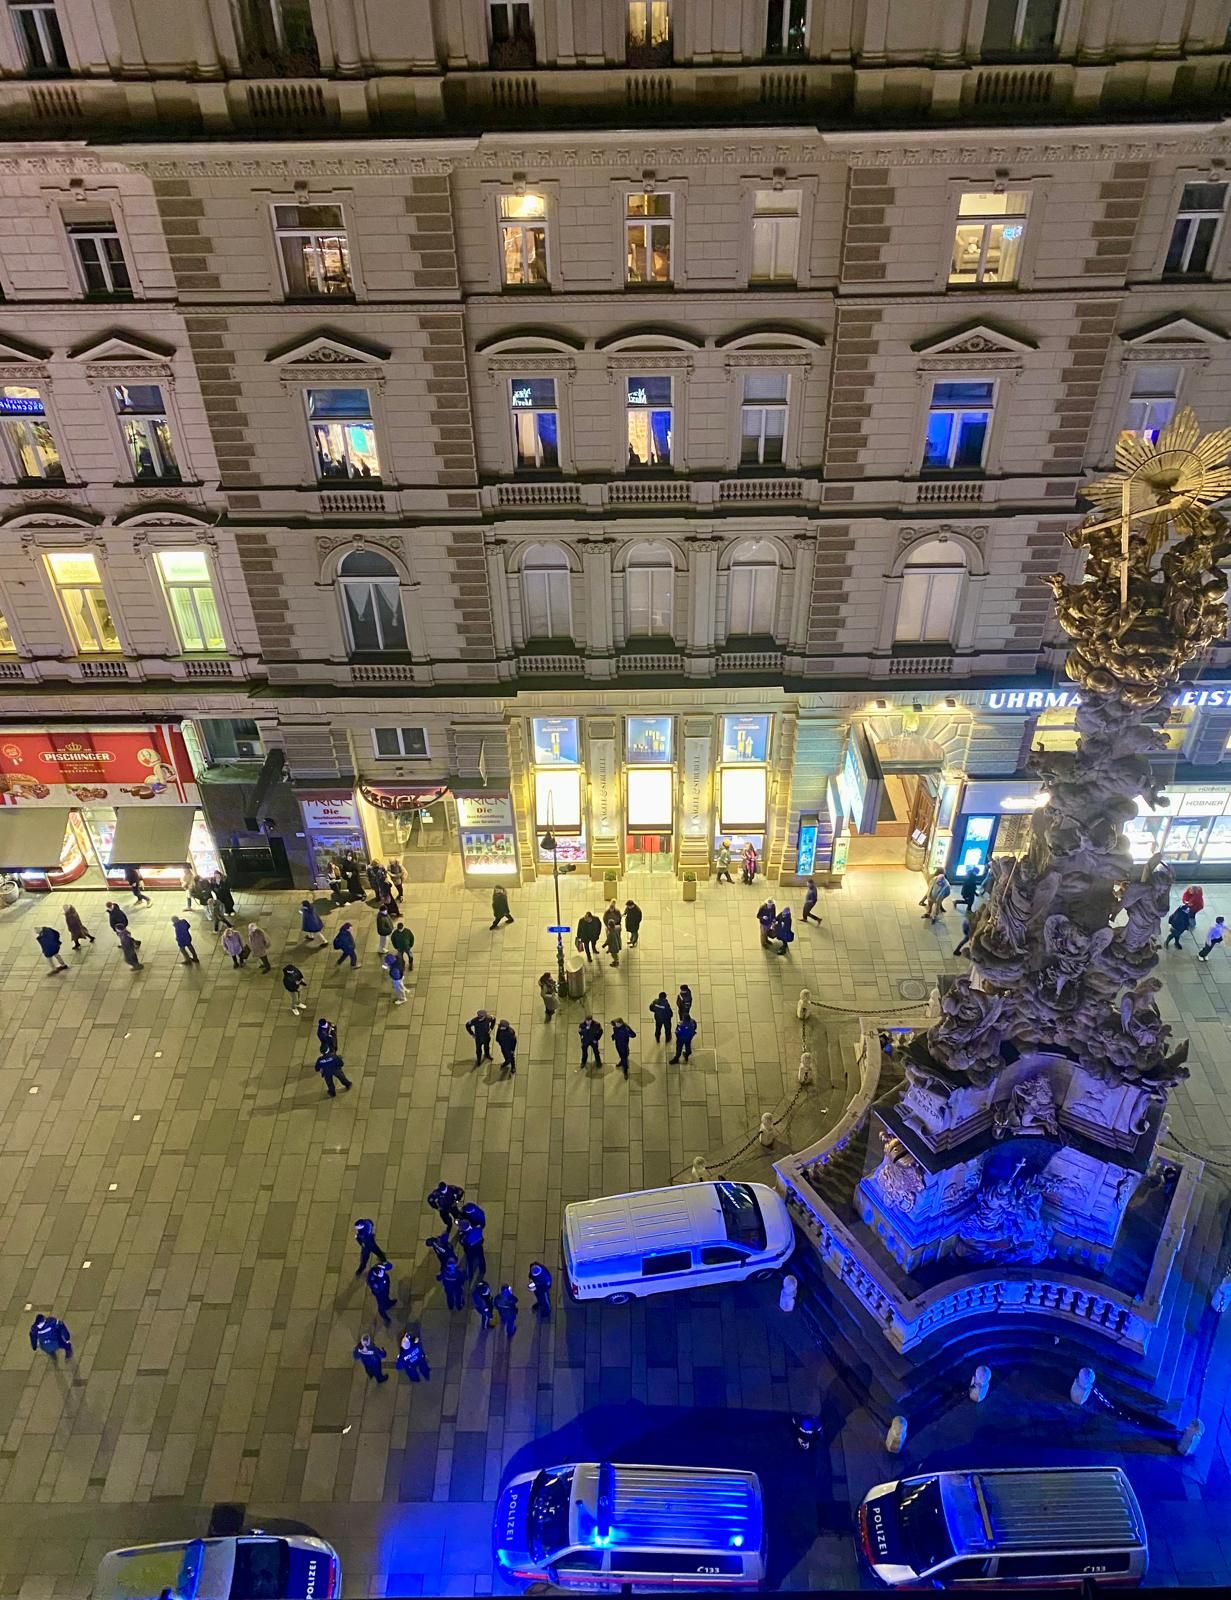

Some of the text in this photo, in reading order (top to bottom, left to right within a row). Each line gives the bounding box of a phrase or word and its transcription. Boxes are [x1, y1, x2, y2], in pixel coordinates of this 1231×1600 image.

[44, 752, 110, 761] PISCHINGER
[505, 1493, 519, 1541] POLIZEI
[872, 1506, 888, 1555] POLIZEI
[305, 1560, 317, 1600] POLIZEI
